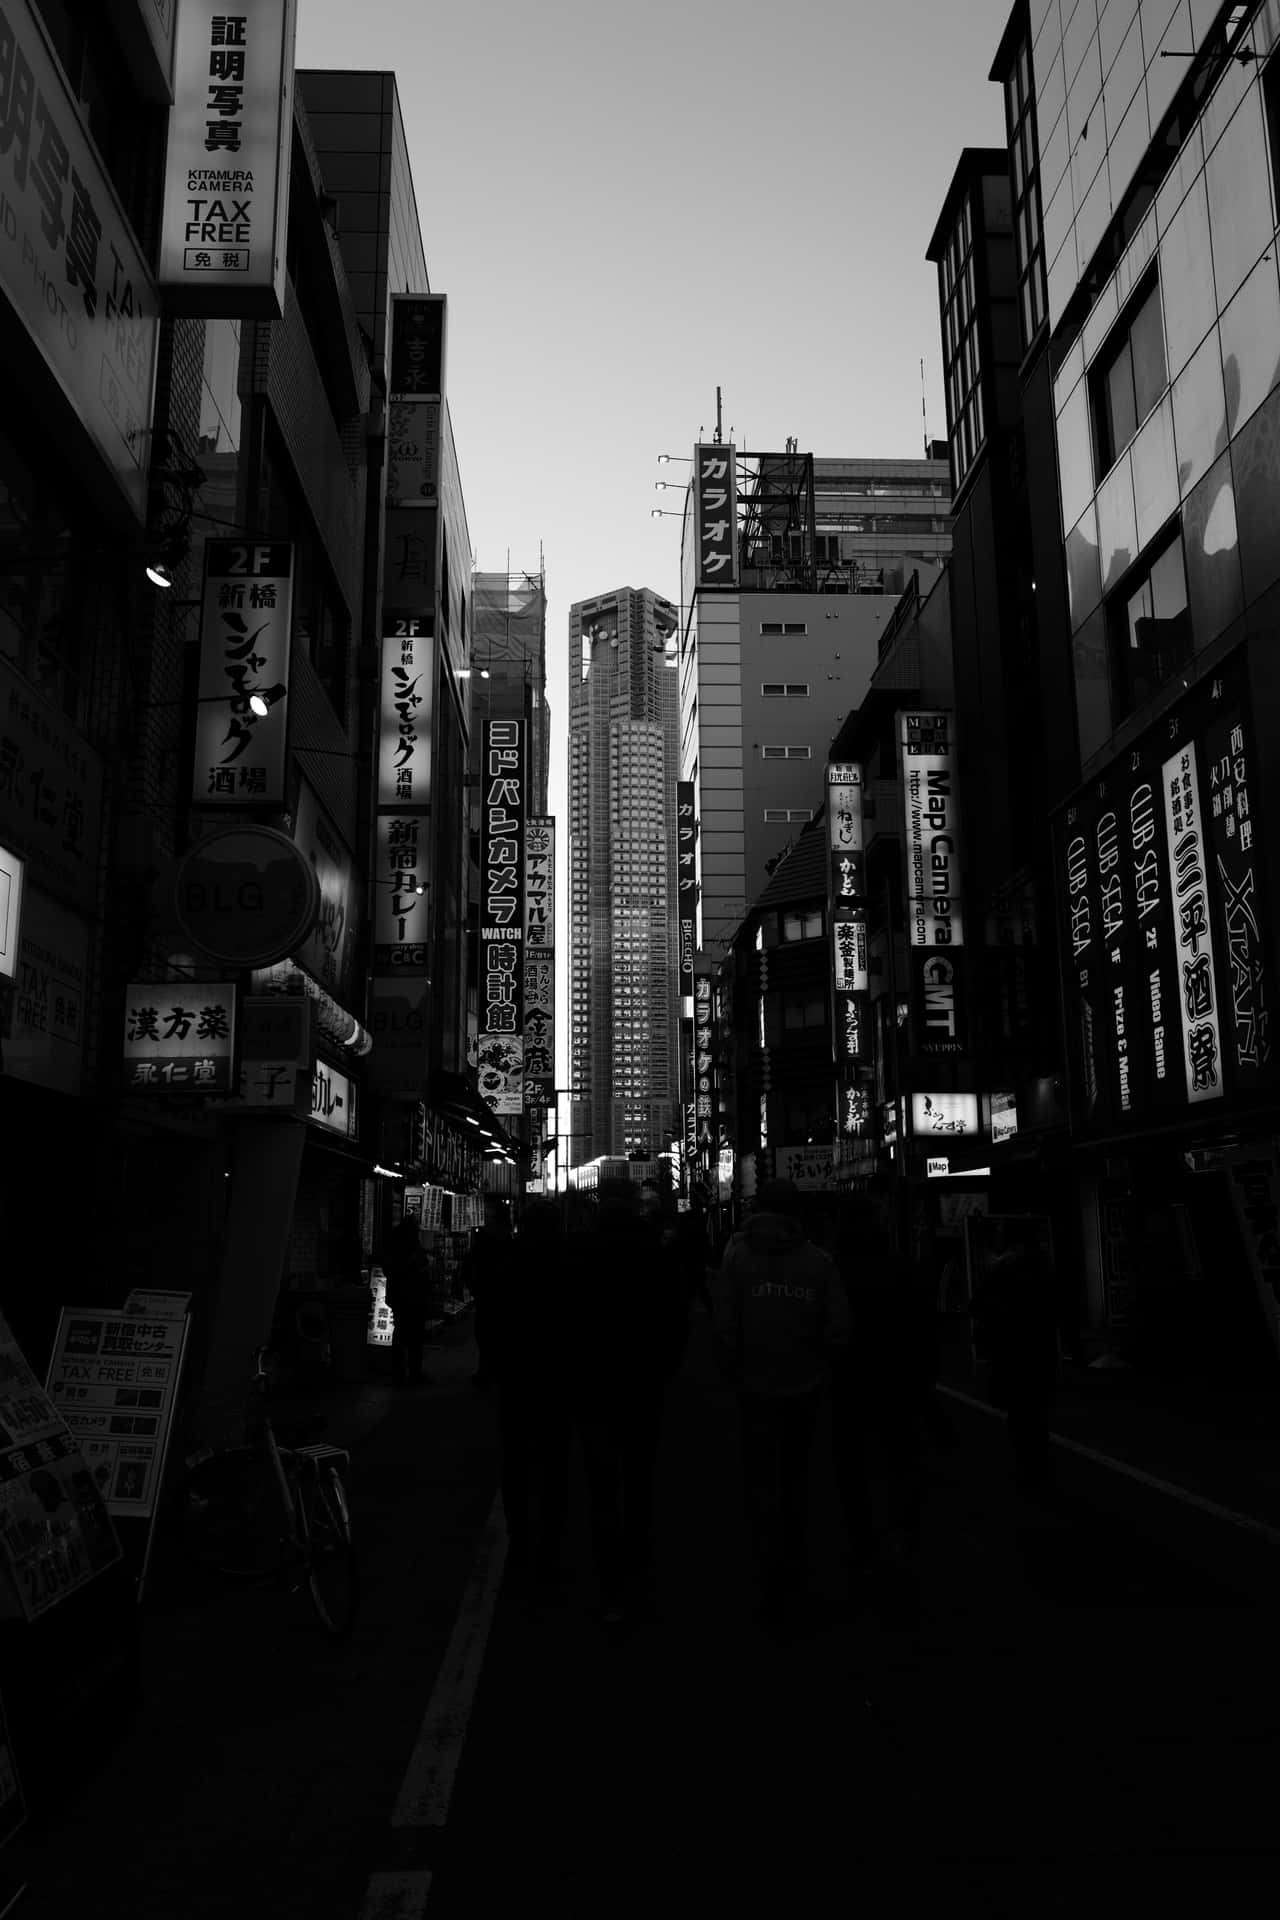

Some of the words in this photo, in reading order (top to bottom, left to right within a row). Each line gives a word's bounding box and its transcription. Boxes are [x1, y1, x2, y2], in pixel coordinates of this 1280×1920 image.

[204, 16, 247, 152] 証明写真
[187, 181, 254, 192] CAMERA
[188, 170, 254, 180] KITAMURA
[185, 224, 250, 243] FREE
[187, 200, 251, 222] TAX
[194, 252, 240, 267] 免税
[701, 458, 731, 573] カラオケ
[227, 547, 272, 575] 2F
[218, 583, 277, 608] 新橋
[395, 619, 420, 637] 2F
[208, 767, 266, 793] 酒場
[396, 768, 412, 800] 酒場
[487, 720, 520, 923] ヨドバシカメラ
[1097, 812, 1119, 874] CLUB
[1130, 784, 1154, 850] CLUB
[678, 803, 695, 891] カラオケ
[910, 770, 926, 945] http://www.mapcamera.com
[1067, 836, 1088, 896] CLUB
[186, 881, 264, 912] BLG
[388, 820, 419, 941] 新宿カレー
[527, 853, 549, 945] アカマル屋
[931, 835, 954, 945] Camera
[1101, 874, 1124, 940] SEGA
[1134, 850, 1160, 921] SEGA
[482, 928, 521, 941] WATCH
[1070, 896, 1093, 957] SEGA
[1146, 927, 1158, 950] 2F
[838, 924, 856, 991] 楽釜製麺所
[486, 943, 517, 1033] 時計館
[923, 956, 955, 1037] GMT
[1150, 969, 1162, 1022] Video
[128, 1006, 229, 1041] 漢方薬
[374, 1011, 423, 1032] BLG
[525, 1008, 552, 1074] 金の蔵
[1113, 986, 1125, 1035] Prize
[1119, 1056, 1131, 1111] Medal
[130, 1058, 217, 1086] 永仁堂
[696, 977, 713, 1144] カラオケの鉄人
[1153, 1026, 1166, 1079] Game
[104, 1322, 167, 1338] 新宿中古
[62, 1367, 91, 1379] TAX
[99, 1368, 136, 1382] FREE
